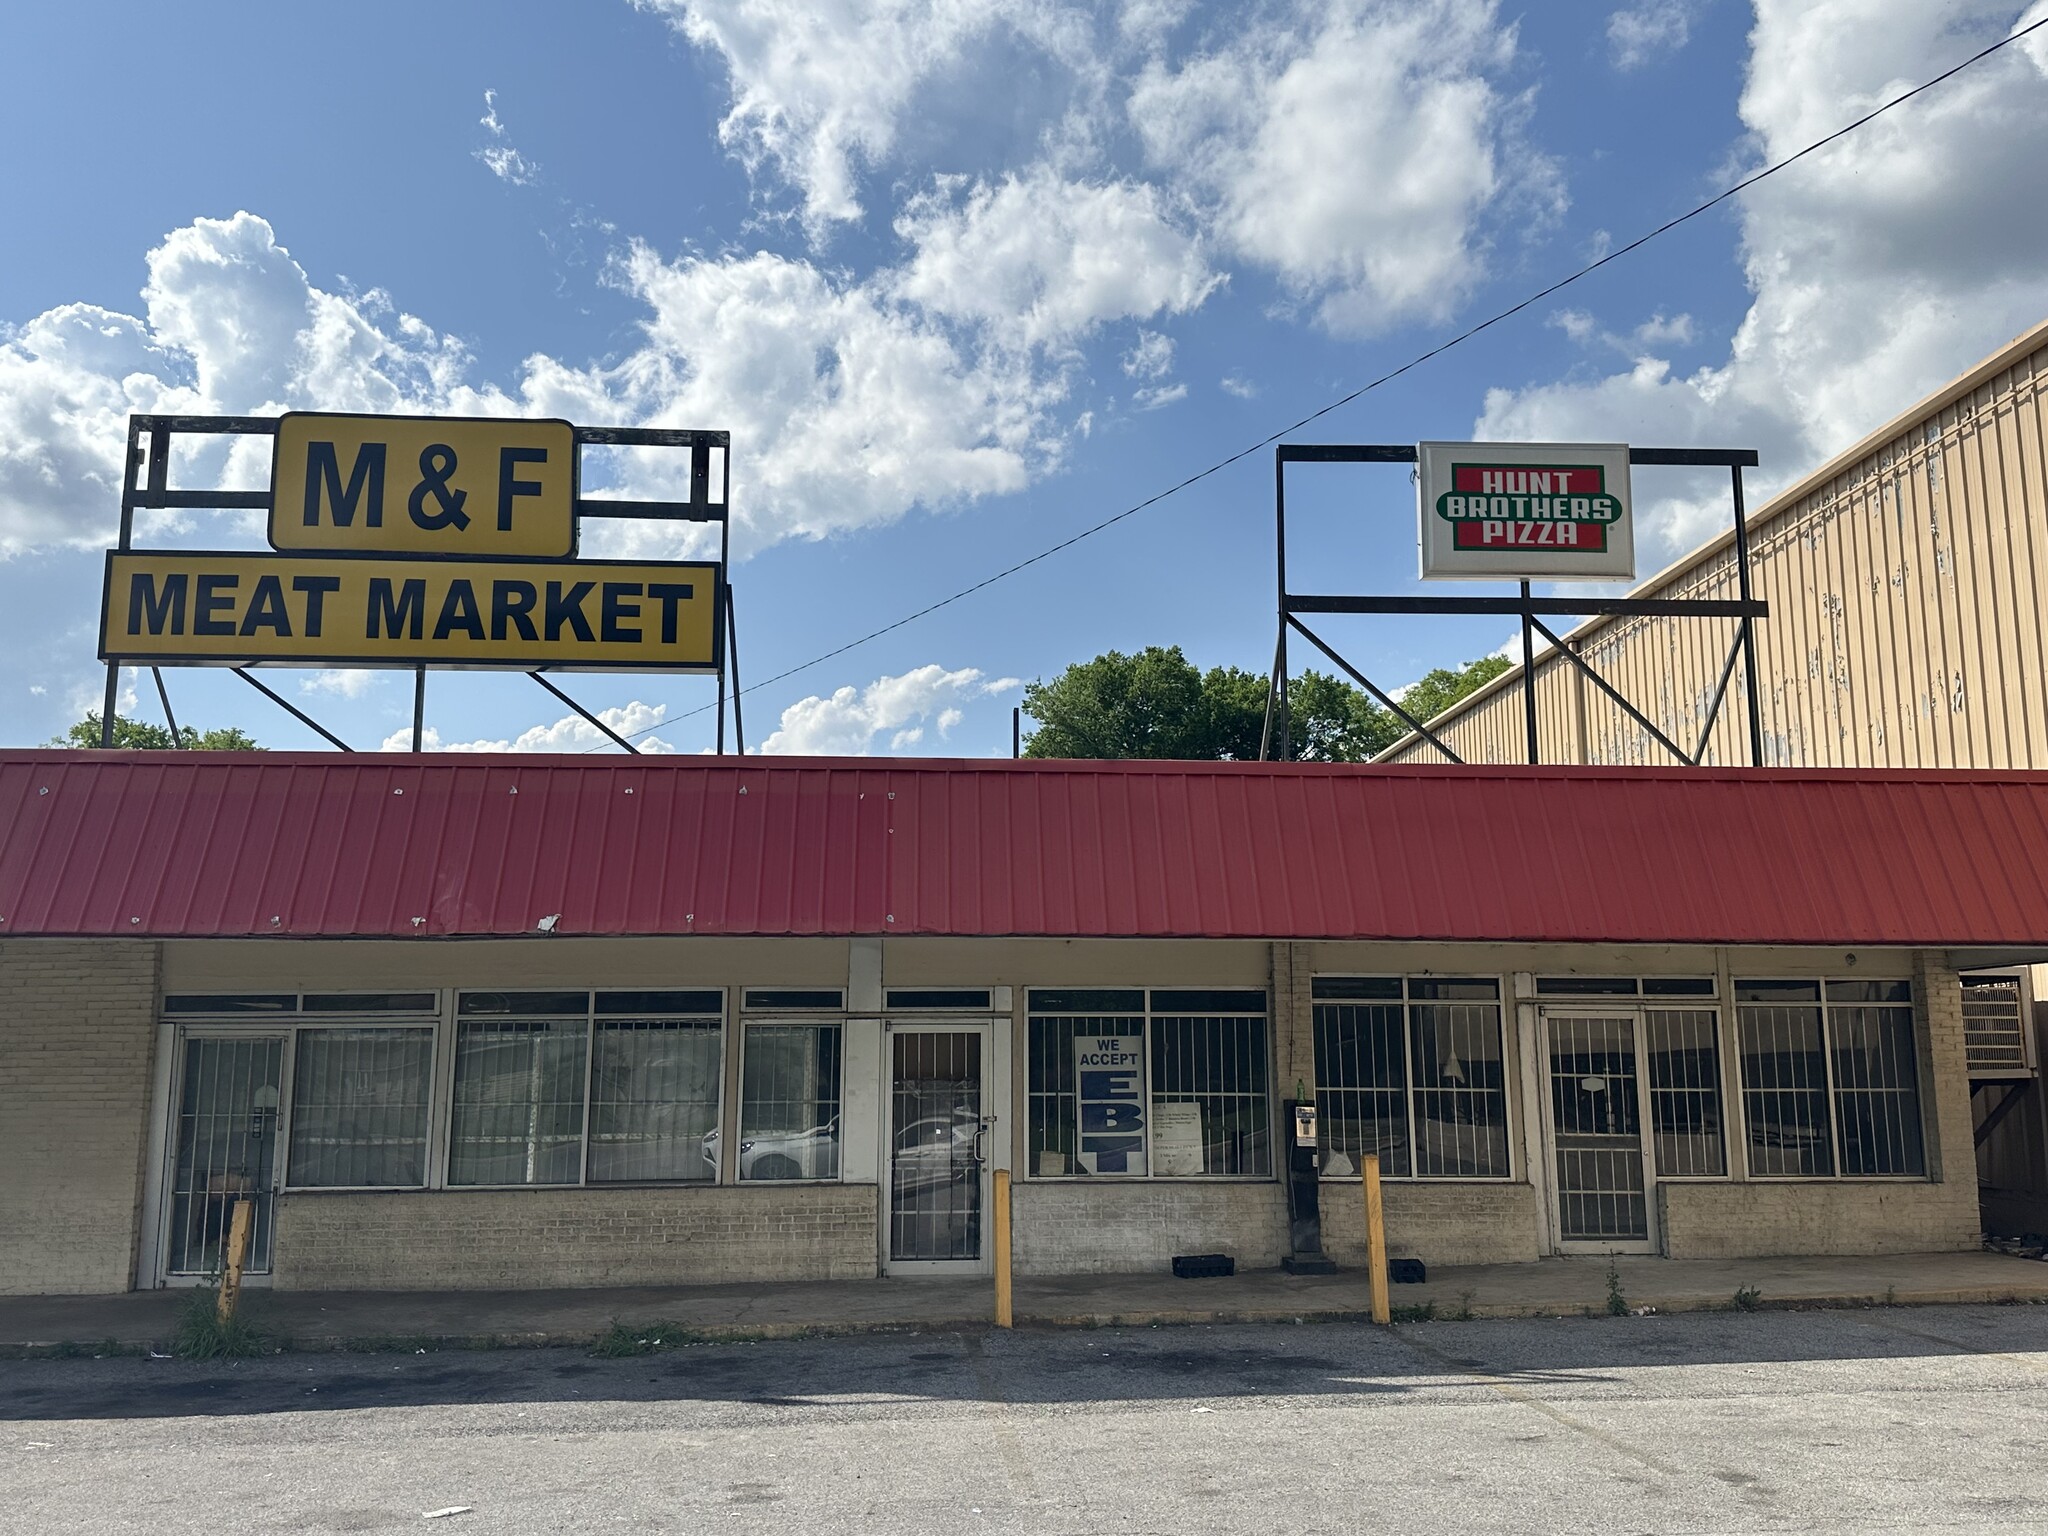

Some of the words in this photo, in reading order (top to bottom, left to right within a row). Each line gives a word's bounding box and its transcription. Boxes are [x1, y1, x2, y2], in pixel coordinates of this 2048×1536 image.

[303, 441, 387, 528] M
[407, 443, 471, 532] &
[496, 447, 549, 532] F
[1482, 471, 1573, 495] HUNT
[1446, 496, 1612, 520] BROTHERS
[1482, 520, 1578, 545] PIZZA
[126, 573, 341, 638] MEAT
[366, 577, 694, 644] MARKET
[1097, 1039, 1120, 1051] WE
[1080, 1053, 1138, 1066] ACCEPT
[1080, 1070, 1144, 1172] EBT
